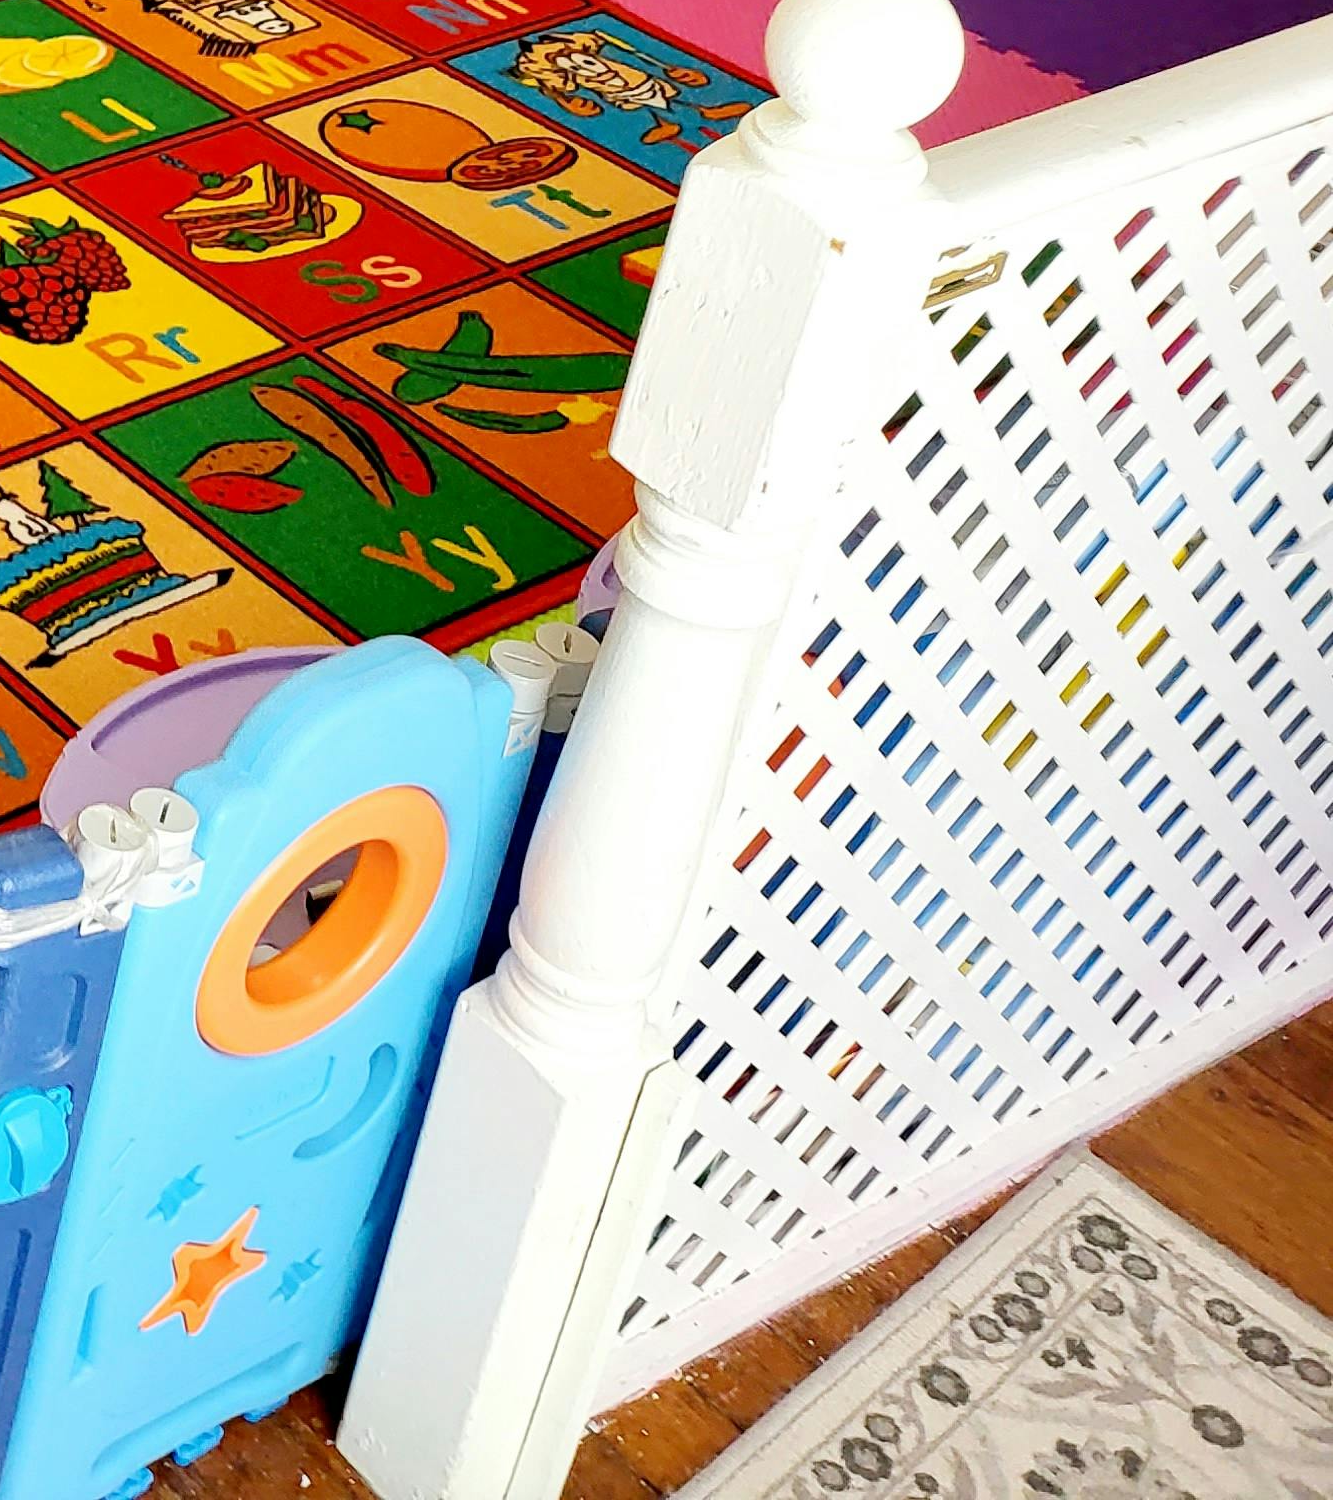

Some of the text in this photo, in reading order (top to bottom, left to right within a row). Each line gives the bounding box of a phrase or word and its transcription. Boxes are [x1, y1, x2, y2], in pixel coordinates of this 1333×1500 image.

[219, 41, 369, 95] Mm
[489, 184, 612, 230] Tt
[300, 256, 423, 304] Ss
[84, 324, 201, 383] Rr
[360, 523, 516, 592] Yy
